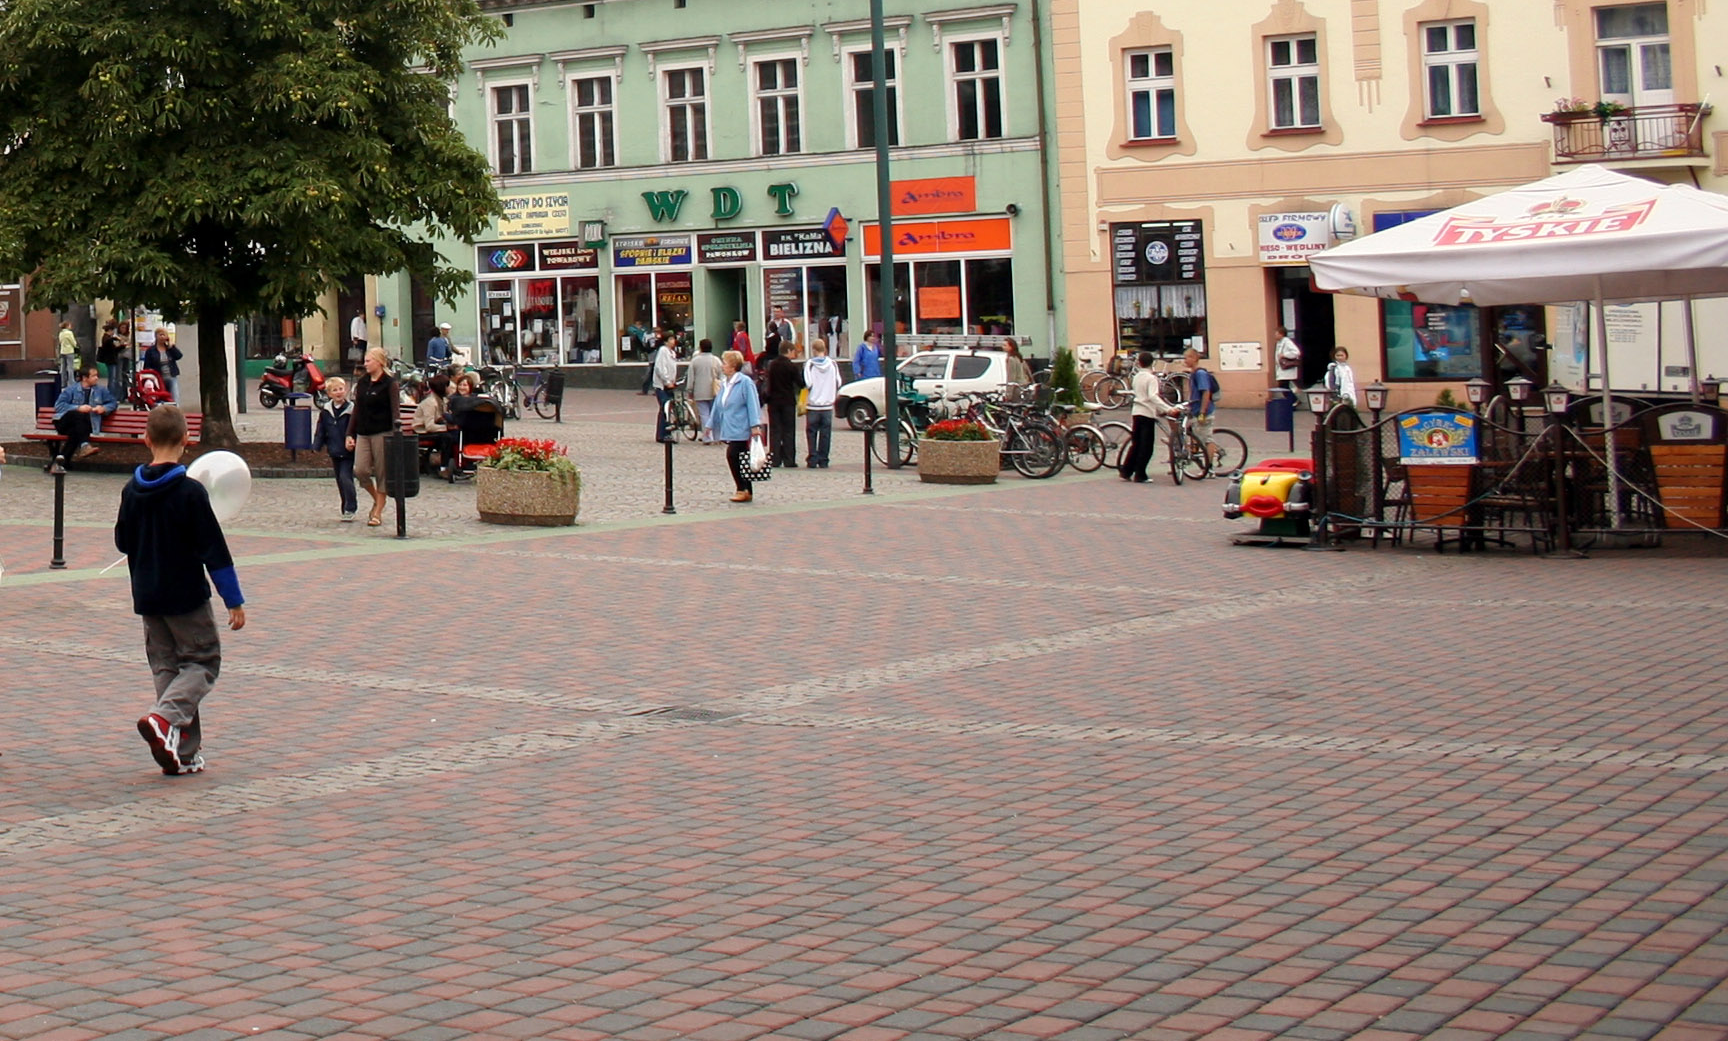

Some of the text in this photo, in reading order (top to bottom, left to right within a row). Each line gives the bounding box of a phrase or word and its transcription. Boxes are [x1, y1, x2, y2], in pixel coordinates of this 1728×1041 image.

[901, 190, 964, 204] Ambra
[1454, 215, 1629, 244] TYSKIE
[898, 231, 976, 246] Ambra
[769, 241, 833, 256] BIELIZNA
[1410, 447, 1469, 457] ZALEWSKI
